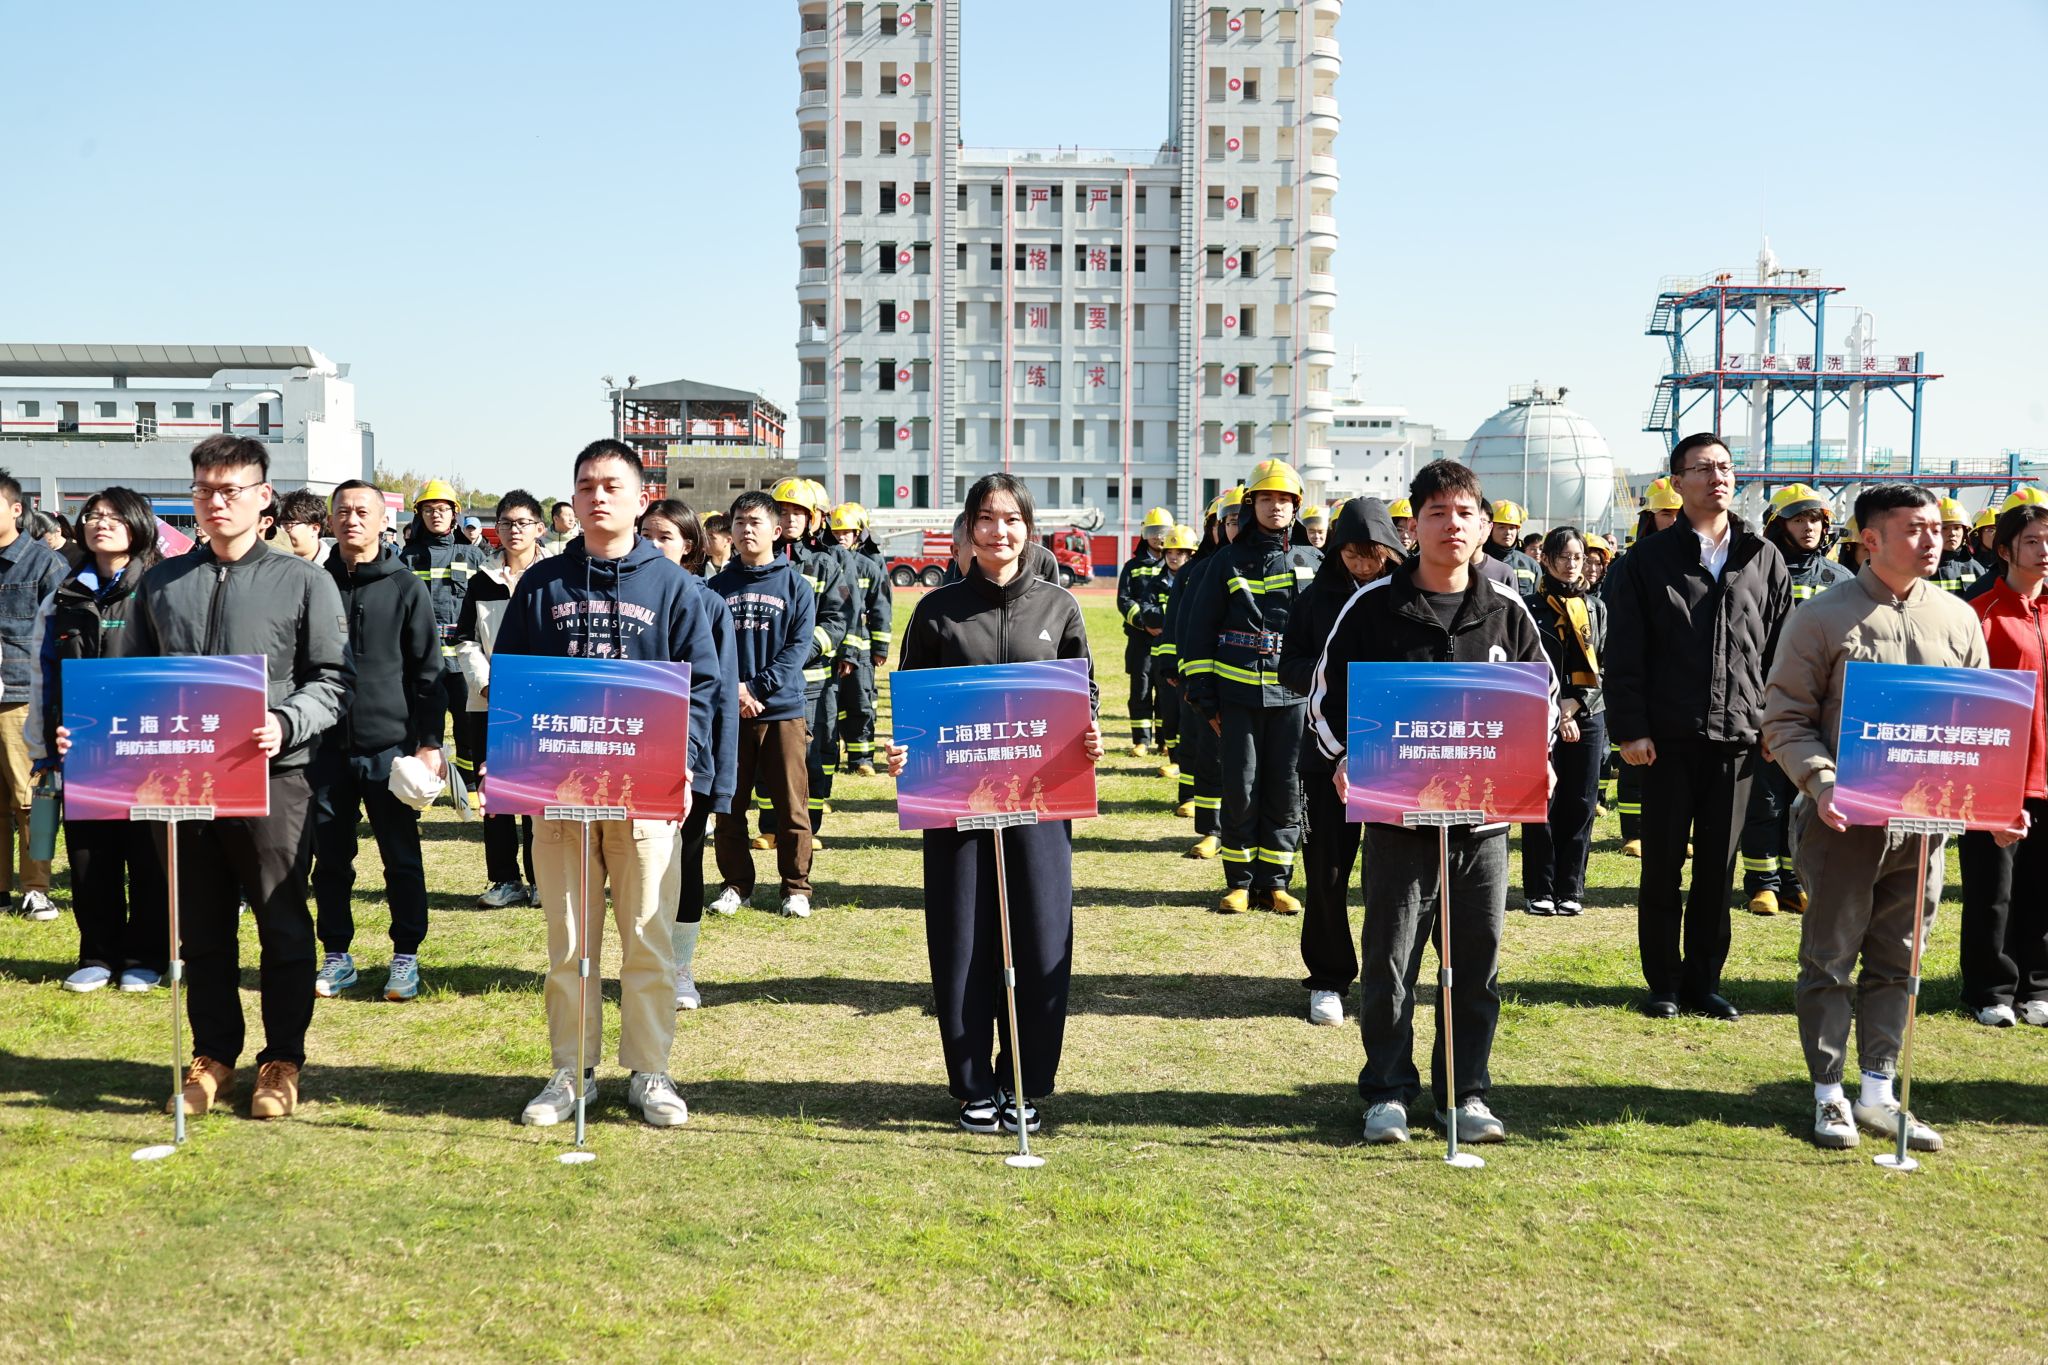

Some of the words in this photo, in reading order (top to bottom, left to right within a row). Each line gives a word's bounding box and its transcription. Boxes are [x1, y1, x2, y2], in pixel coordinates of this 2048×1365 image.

[1027, 189, 1049, 388] 严格训练
[1087, 189, 1109, 388] 严格要求
[1728, 355, 1911, 372] 乙烯碱洗装置
[551, 601, 577, 619] EAST
[731, 604, 781, 616] NIVERSITY
[556, 618, 645, 635] UNIVERSITY
[109, 714, 220, 734] 上海大学
[531, 713, 644, 735] 华东师范大学
[937, 719, 1047, 744] 上海理工大学
[1391, 720, 1504, 739] 上海交通大学
[1859, 721, 2011, 747] 上海交通大学医学院
[115, 739, 215, 755] 消防志愿服务站
[538, 737, 636, 756] 消防志愿服务站
[945, 744, 1042, 764] 消防志愿服务站
[1399, 744, 1496, 760] 消防志愿服务站
[1886, 747, 1980, 766] 消防志愿服务站
